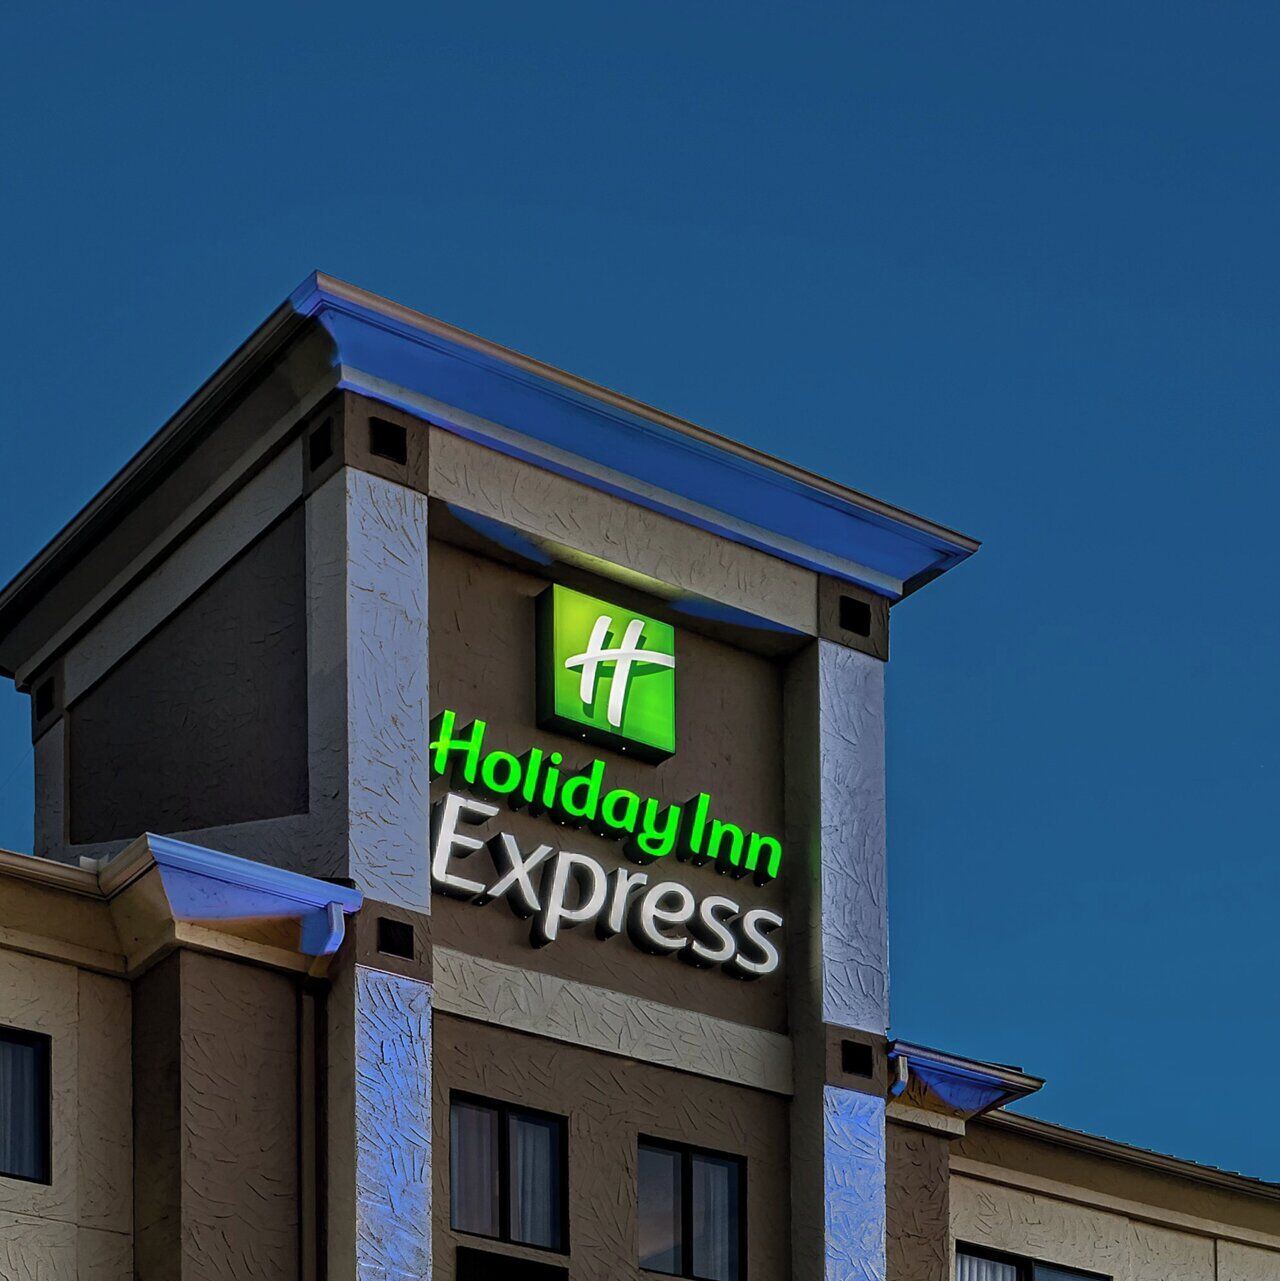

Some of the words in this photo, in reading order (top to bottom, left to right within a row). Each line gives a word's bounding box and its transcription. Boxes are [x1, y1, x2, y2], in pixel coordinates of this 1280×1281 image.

[428, 709, 681, 857] Holiday
[690, 792, 783, 879] Inn
[431, 792, 783, 973] Express
